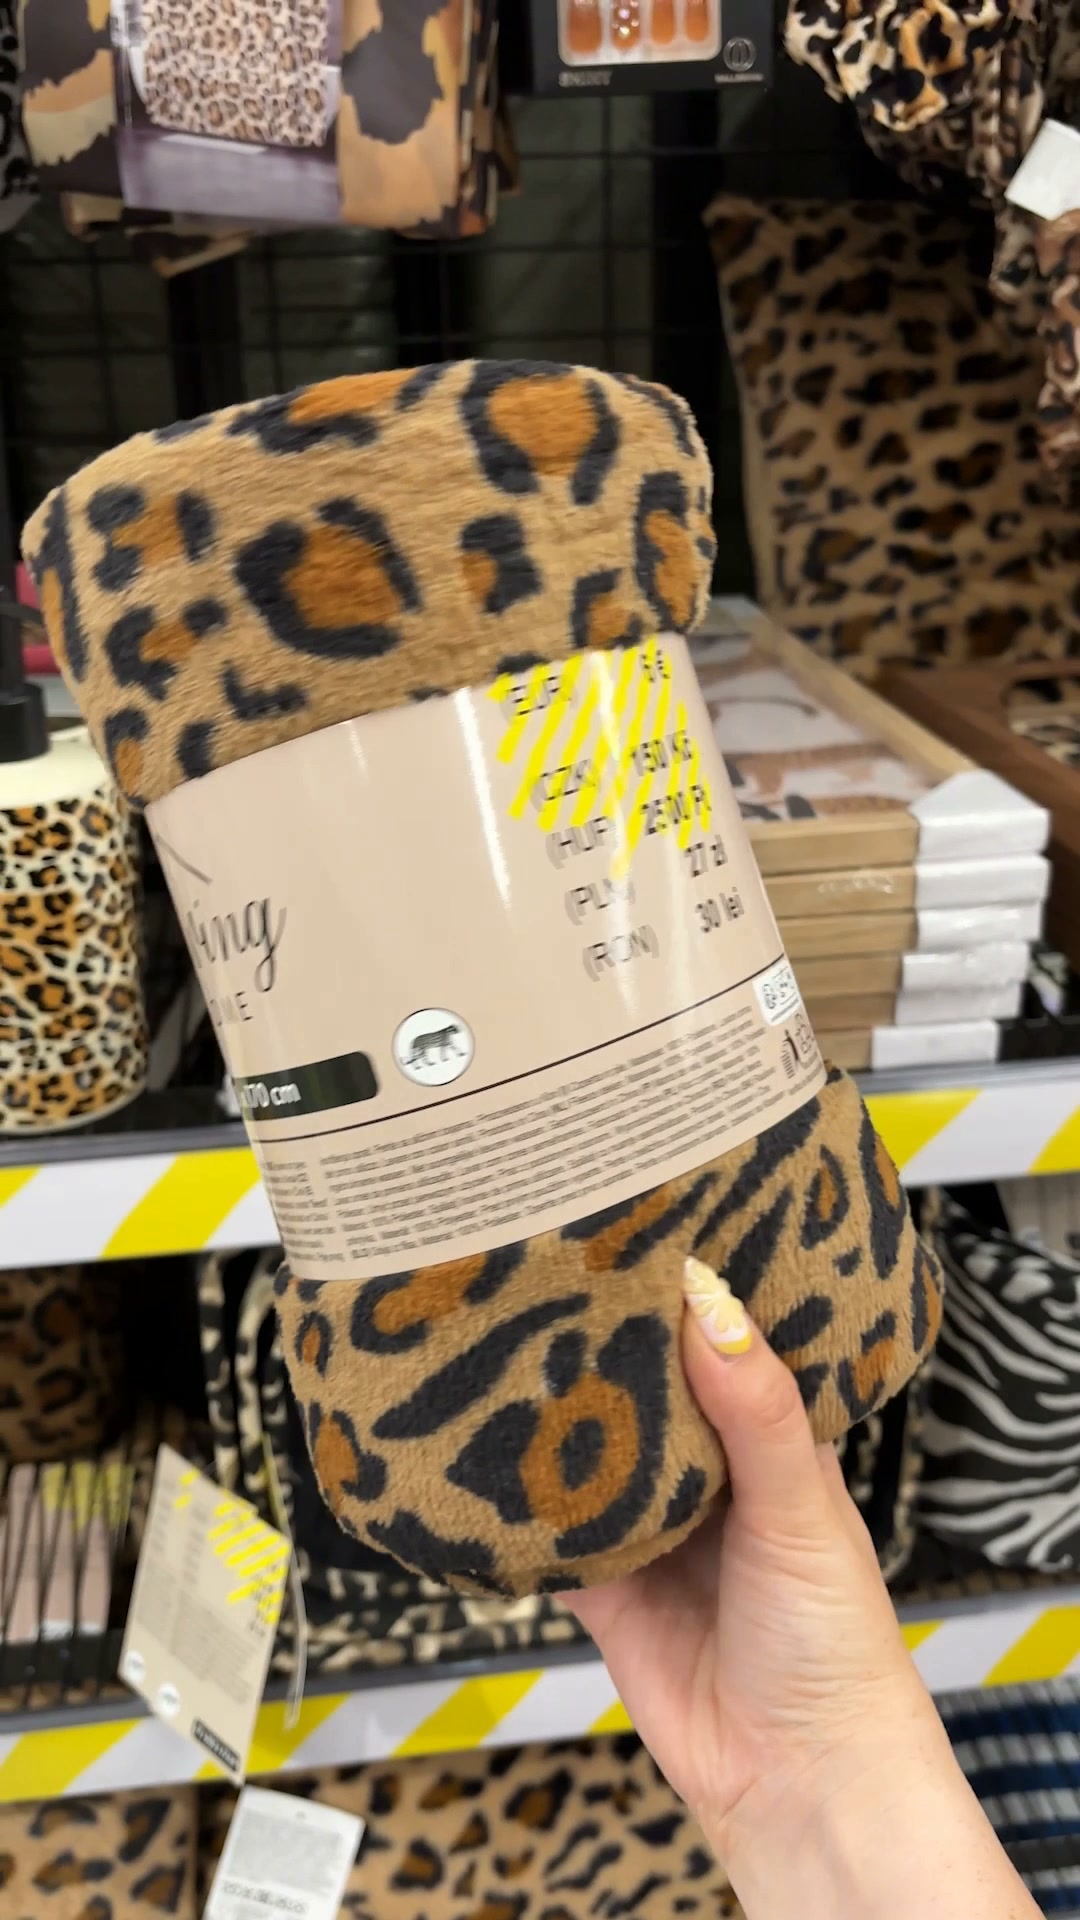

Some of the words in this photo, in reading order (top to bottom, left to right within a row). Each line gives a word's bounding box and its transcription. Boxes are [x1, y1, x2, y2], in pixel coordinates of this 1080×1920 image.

[631, 738, 668, 777] 150
[640, 790, 691, 836] 2500
[685, 841, 708, 878] 27
[696, 898, 721, 934] 30
[719, 885, 745, 922] lei
[269, 1082, 302, 1107] cm
